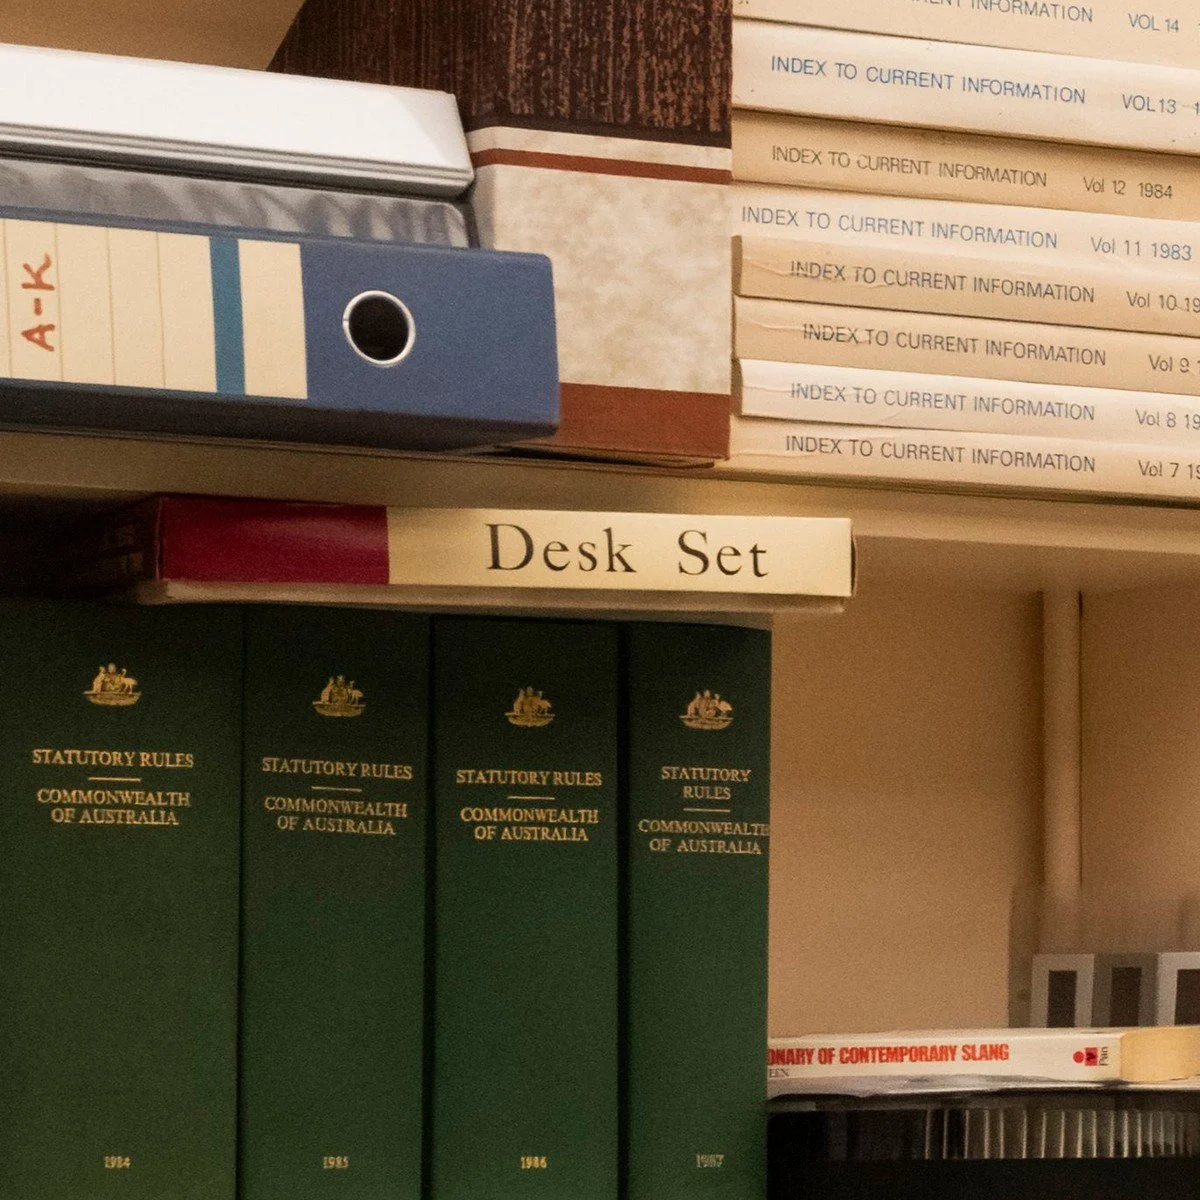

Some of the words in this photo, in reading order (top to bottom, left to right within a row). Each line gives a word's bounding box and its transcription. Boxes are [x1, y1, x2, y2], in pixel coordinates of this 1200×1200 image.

[771, 56, 827, 77] INDEX
[835, 62, 858, 80] TO
[866, 66, 954, 90] CURRENT
[962, 76, 1086, 104] INFORMATION
[772, 145, 822, 166] INDEX
[828, 151, 850, 168] TO
[856, 154, 932, 176] CURRENT
[938, 162, 1047, 187] INFORMATION
[1083, 176, 1105, 193] Vol
[1112, 180, 1126, 195] 12
[1138, 182, 1173, 199] 1984
[742, 206, 799, 227] INDEX
[805, 211, 831, 230] TO
[838, 214, 924, 237] CURRENT
[931, 221, 1058, 249] INFORMATION
[1090, 236, 1115, 255] Vol
[1124, 240, 1141, 256] 11
[1151, 243, 1192, 261] 1983
[790, 260, 846, 282] INDEX
[854, 266, 876, 284] TO
[883, 269, 967, 292] CURRENT
[973, 276, 1095, 303] INFORMATION
[1125, 291, 1150, 308] Vol
[1159, 294, 1177, 311] 10
[20, 253, 55, 353] A-K
[803, 323, 860, 345] INDEX
[864, 328, 889, 347] TO
[896, 331, 979, 355] CURRENT
[985, 339, 1107, 366] INFORMATION
[1148, 354, 1173, 372] Vol
[1179, 357, 1190, 373] 9
[791, 383, 846, 403] INDEX
[852, 386, 876, 405] TO
[883, 390, 967, 412] CURRENT
[973, 396, 1095, 421] INFORMATION
[1135, 408, 1160, 427] Vol
[1166, 412, 1177, 428] 8
[786, 435, 842, 455] INDEX
[848, 439, 873, 457] TO
[880, 441, 965, 464] CURRENT
[972, 448, 1096, 473] INFORMATION
[1138, 459, 1163, 478] Vol
[1170, 462, 1180, 478] 7
[486, 522, 638, 577] Desk
[676, 529, 769, 579] Set
[32, 749, 134, 768] STATUTORY
[140, 752, 194, 769] RULES
[262, 757, 359, 777] STATUTORY
[360, 763, 413, 780] RULES
[456, 769, 551, 786] STATUTORY
[553, 772, 602, 787] RULES
[661, 766, 752, 782] STATUTORY
[36, 788, 191, 808] COMMONWEALTH
[683, 786, 731, 800] RULES
[51, 808, 75, 825] OF
[80, 808, 179, 826] AUSTRALIA
[264, 797, 408, 818] COMMONWEALTH
[460, 807, 599, 824] COMMONWEALTH
[277, 815, 299, 831] OF
[302, 817, 396, 836] AUSTRALIA
[474, 826, 497, 841] OF
[501, 826, 589, 842] AUSTRALIA
[649, 838, 671, 853] OF
[677, 840, 762, 855] AUSTRALIA
[818, 1047, 835, 1065] OF
[839, 1044, 958, 1064] CONTEMPORARY
[961, 1043, 1010, 1062] SLANG
[520, 1156, 547, 1169] 1986
